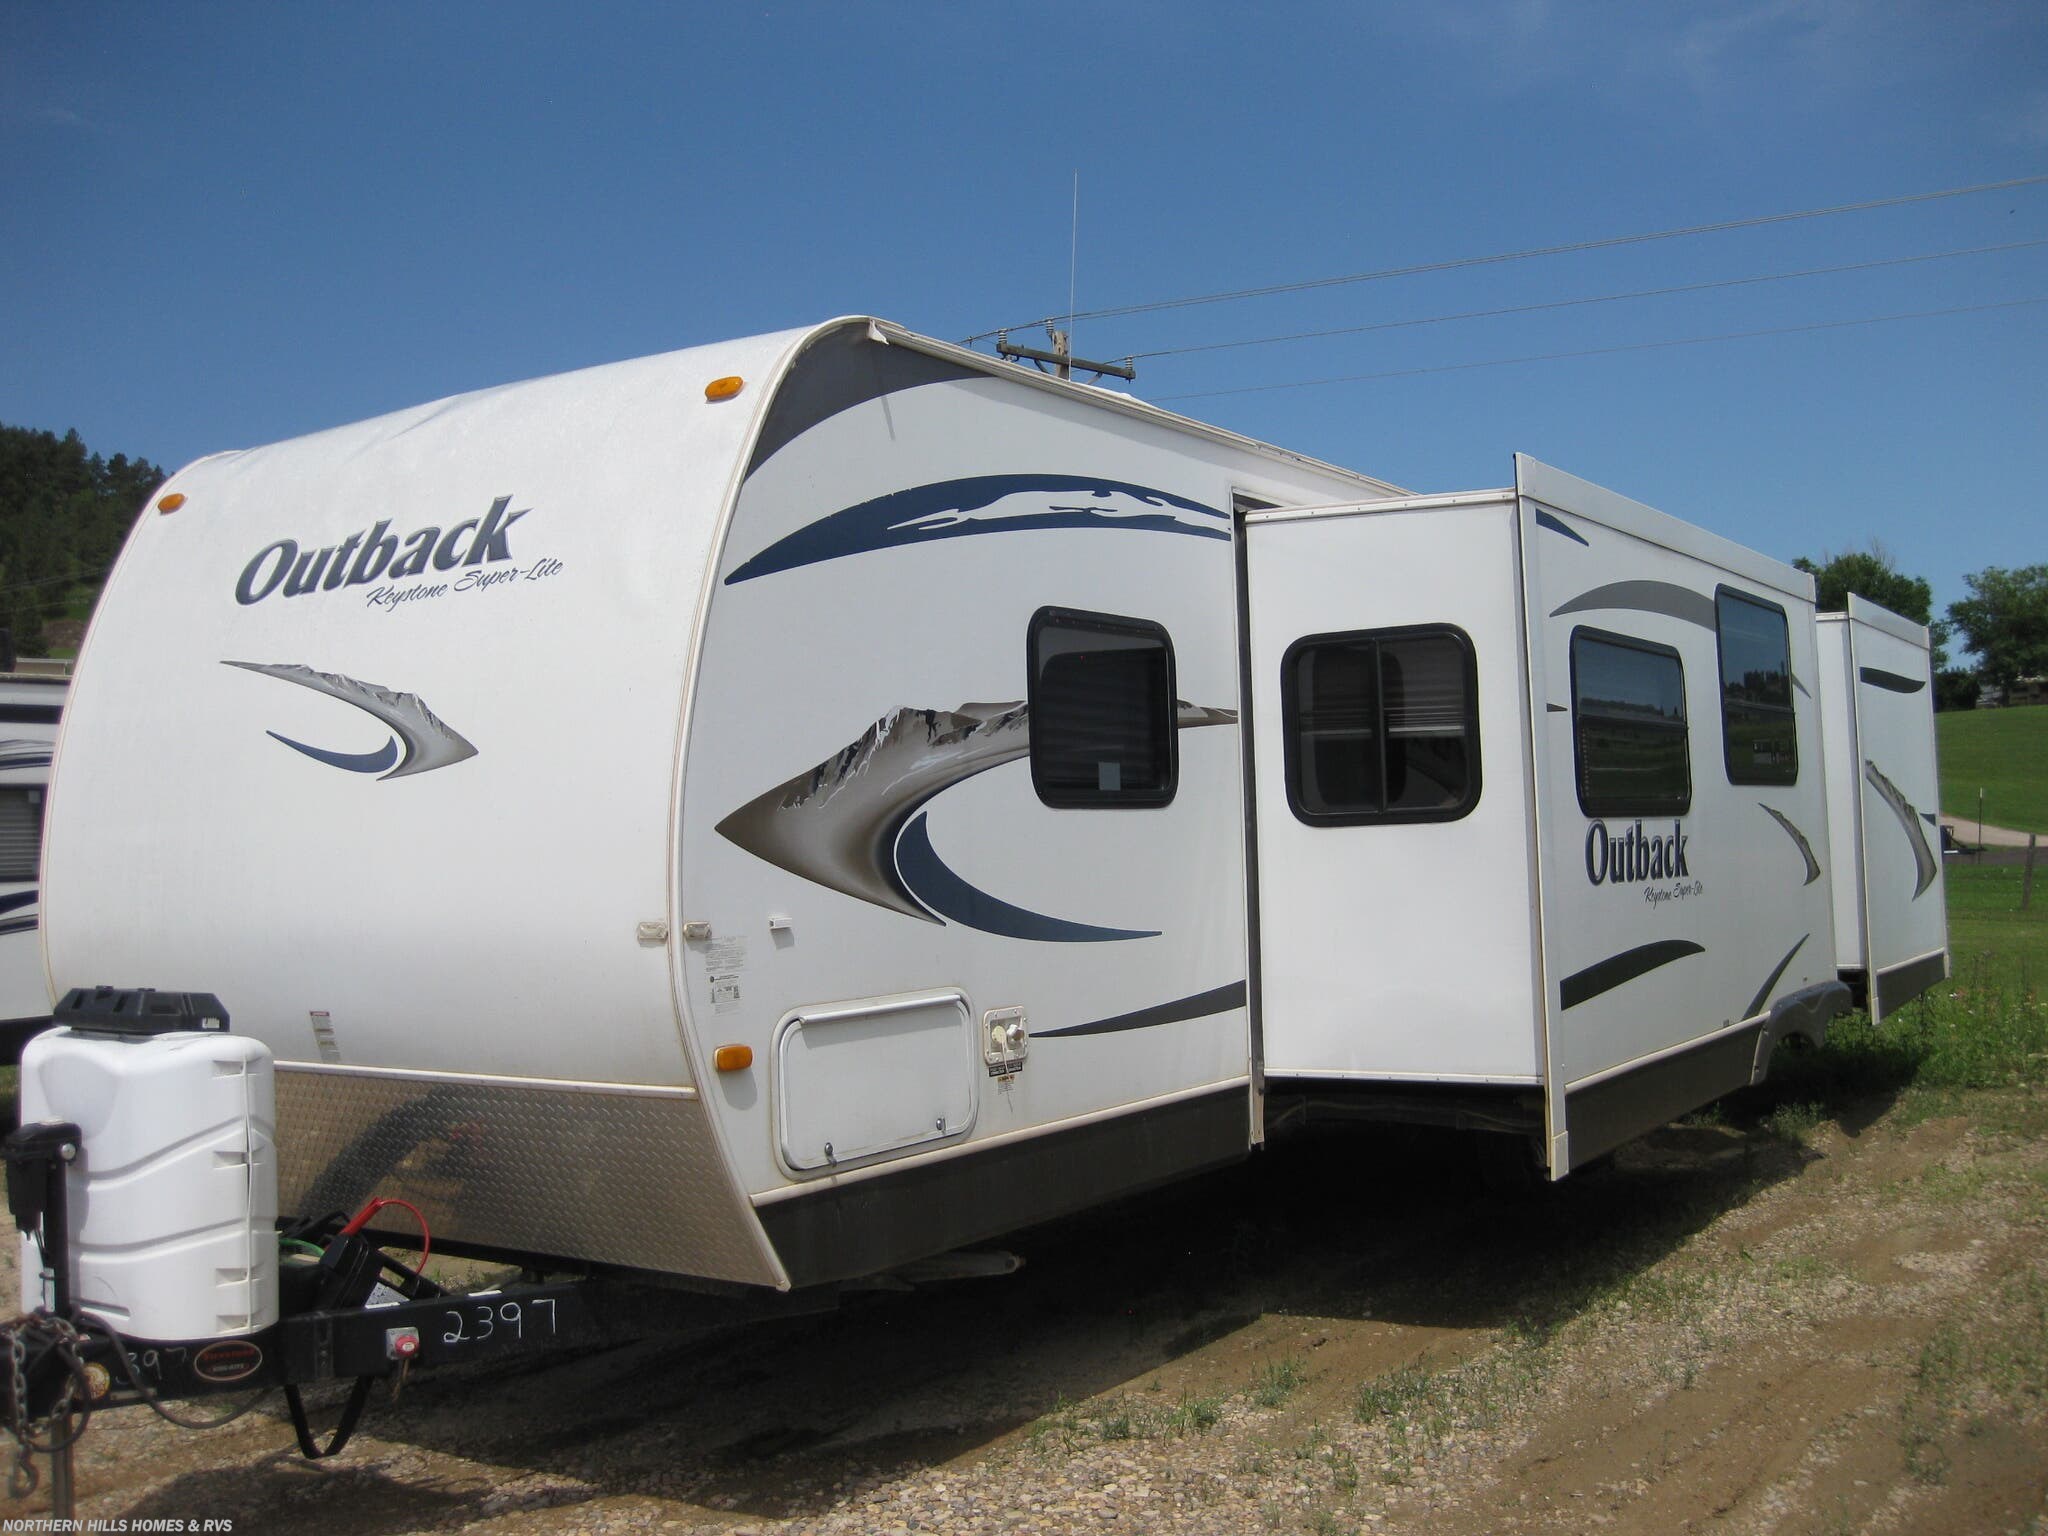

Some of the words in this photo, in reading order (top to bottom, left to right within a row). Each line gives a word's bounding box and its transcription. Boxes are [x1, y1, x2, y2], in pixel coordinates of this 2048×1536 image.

[235, 494, 534, 606] Outback
[366, 583, 449, 612] Keystone
[454, 558, 564, 592] Super-Lite
[1585, 818, 1689, 886] Outback
[443, 1299, 556, 1343] 2397
